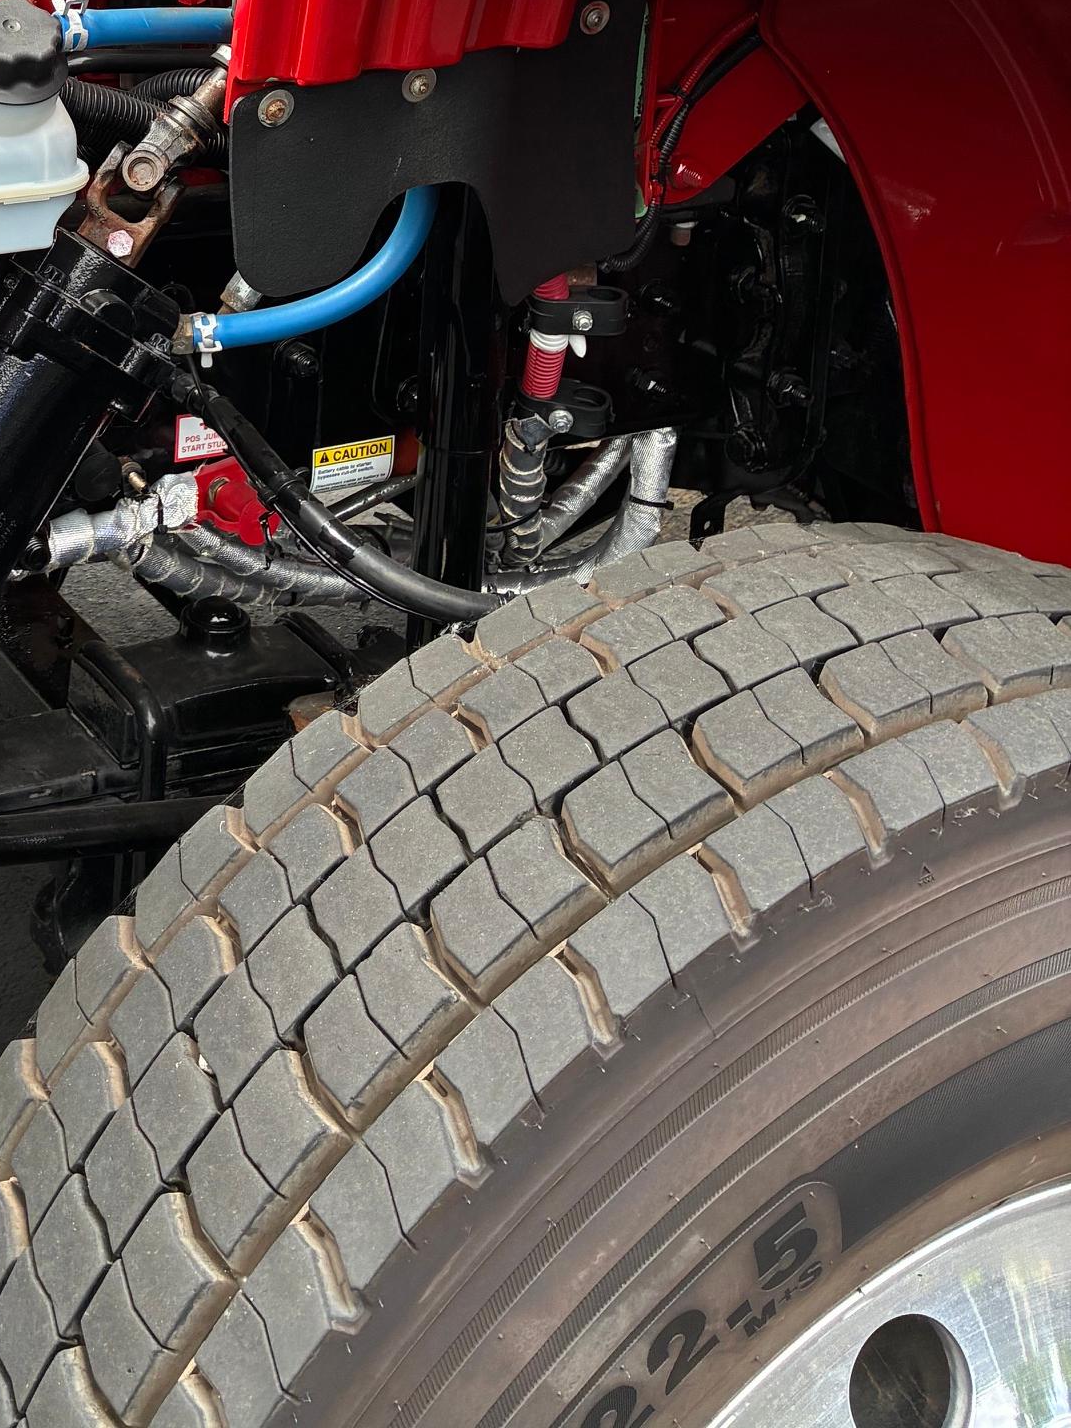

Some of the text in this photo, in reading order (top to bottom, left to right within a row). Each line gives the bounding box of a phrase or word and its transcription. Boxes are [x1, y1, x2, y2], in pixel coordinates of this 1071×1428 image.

[185, 432, 220, 443] POS JUM
[181, 443, 206, 453] START
[207, 440, 227, 449] STUD
[333, 442, 388, 462] CAUTION
[743, 1260, 823, 1338] M+S
